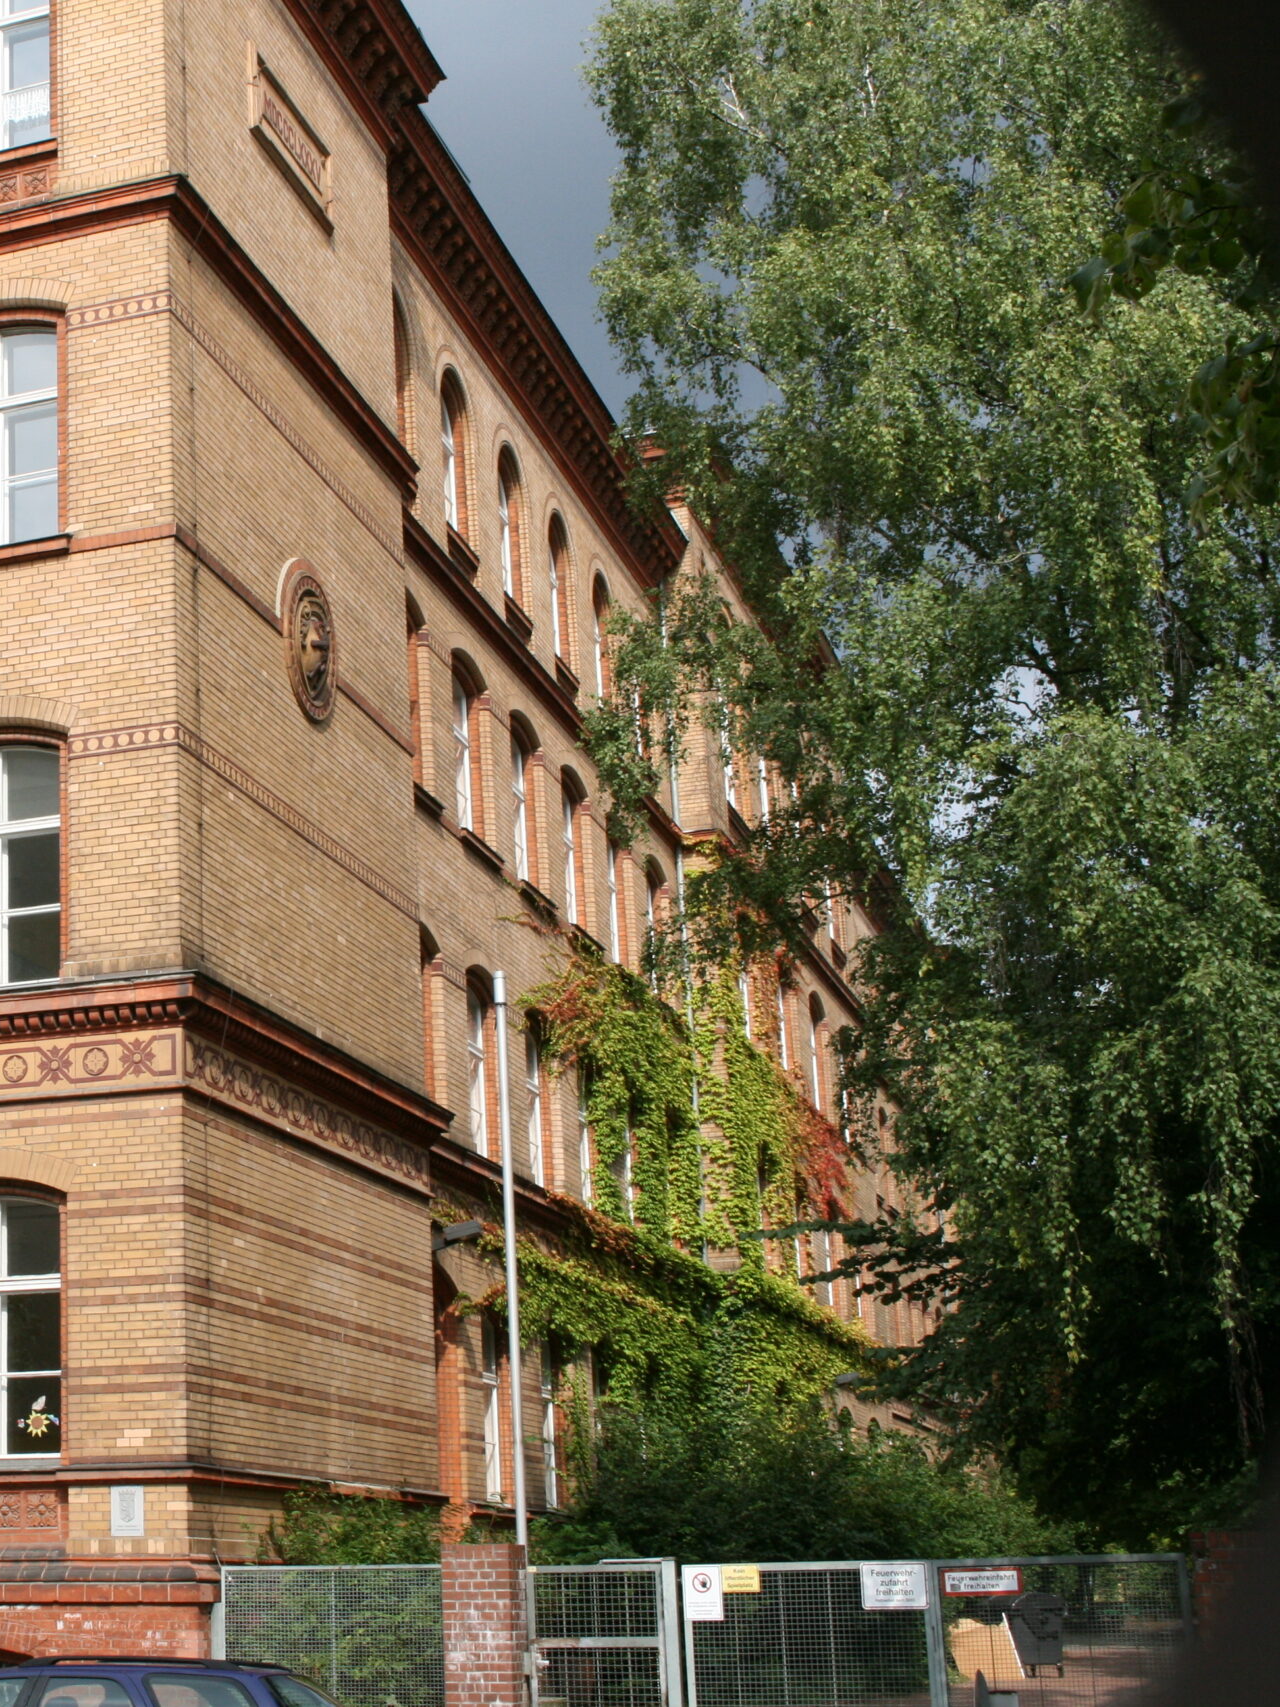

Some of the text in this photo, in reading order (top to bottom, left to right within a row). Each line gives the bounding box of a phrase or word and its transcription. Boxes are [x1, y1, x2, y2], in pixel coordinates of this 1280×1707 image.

[870, 1569, 917, 1577] Feuerwehr-
[947, 1573, 1015, 1582] Feuerwehreinfahrt
[880, 1578, 909, 1587] zufahrt
[964, 1582, 1000, 1590] freihalten
[875, 1588, 914, 1597] freihalten
